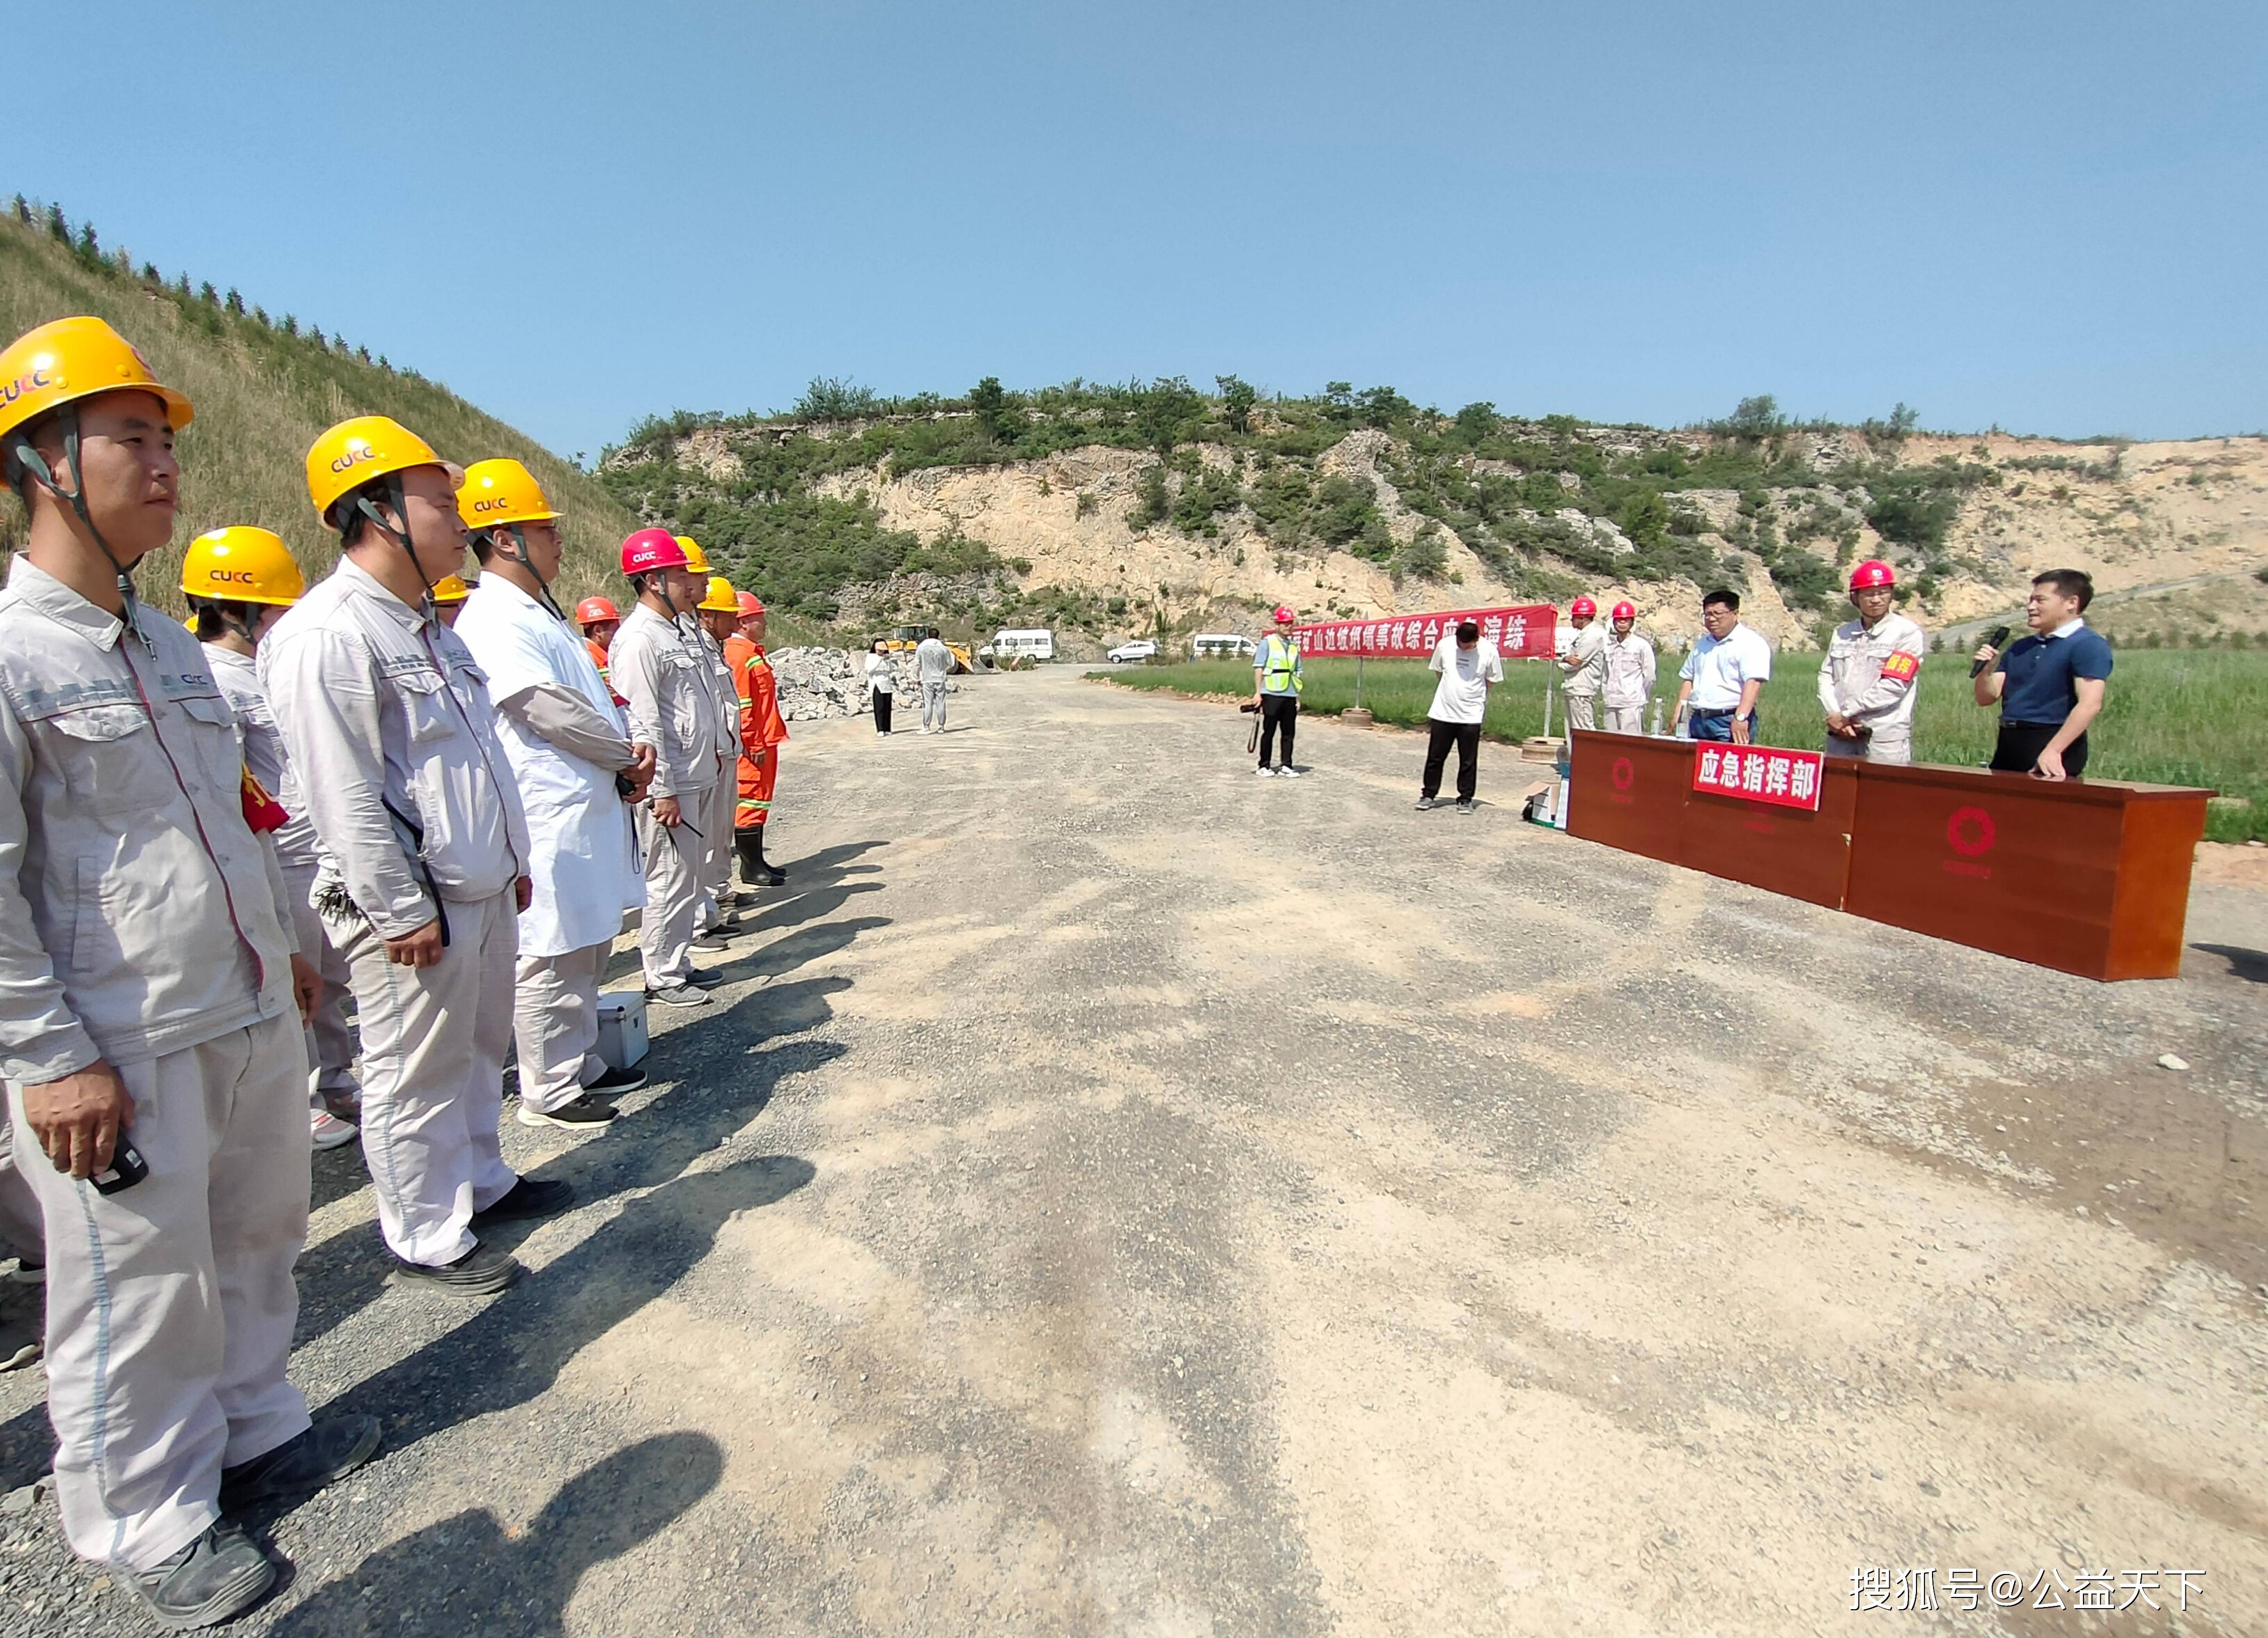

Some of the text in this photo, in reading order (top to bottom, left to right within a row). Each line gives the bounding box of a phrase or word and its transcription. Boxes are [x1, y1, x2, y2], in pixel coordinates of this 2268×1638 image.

[331, 446, 376, 473] CUCC
[474, 497, 508, 512] CUCC
[633, 550, 657, 563] CUCC
[210, 570, 253, 584] CUCC
[1289, 614, 1527, 652] 矿山边坡坍塌事故综合应演练
[1698, 749, 1816, 800] 应急指挥部
